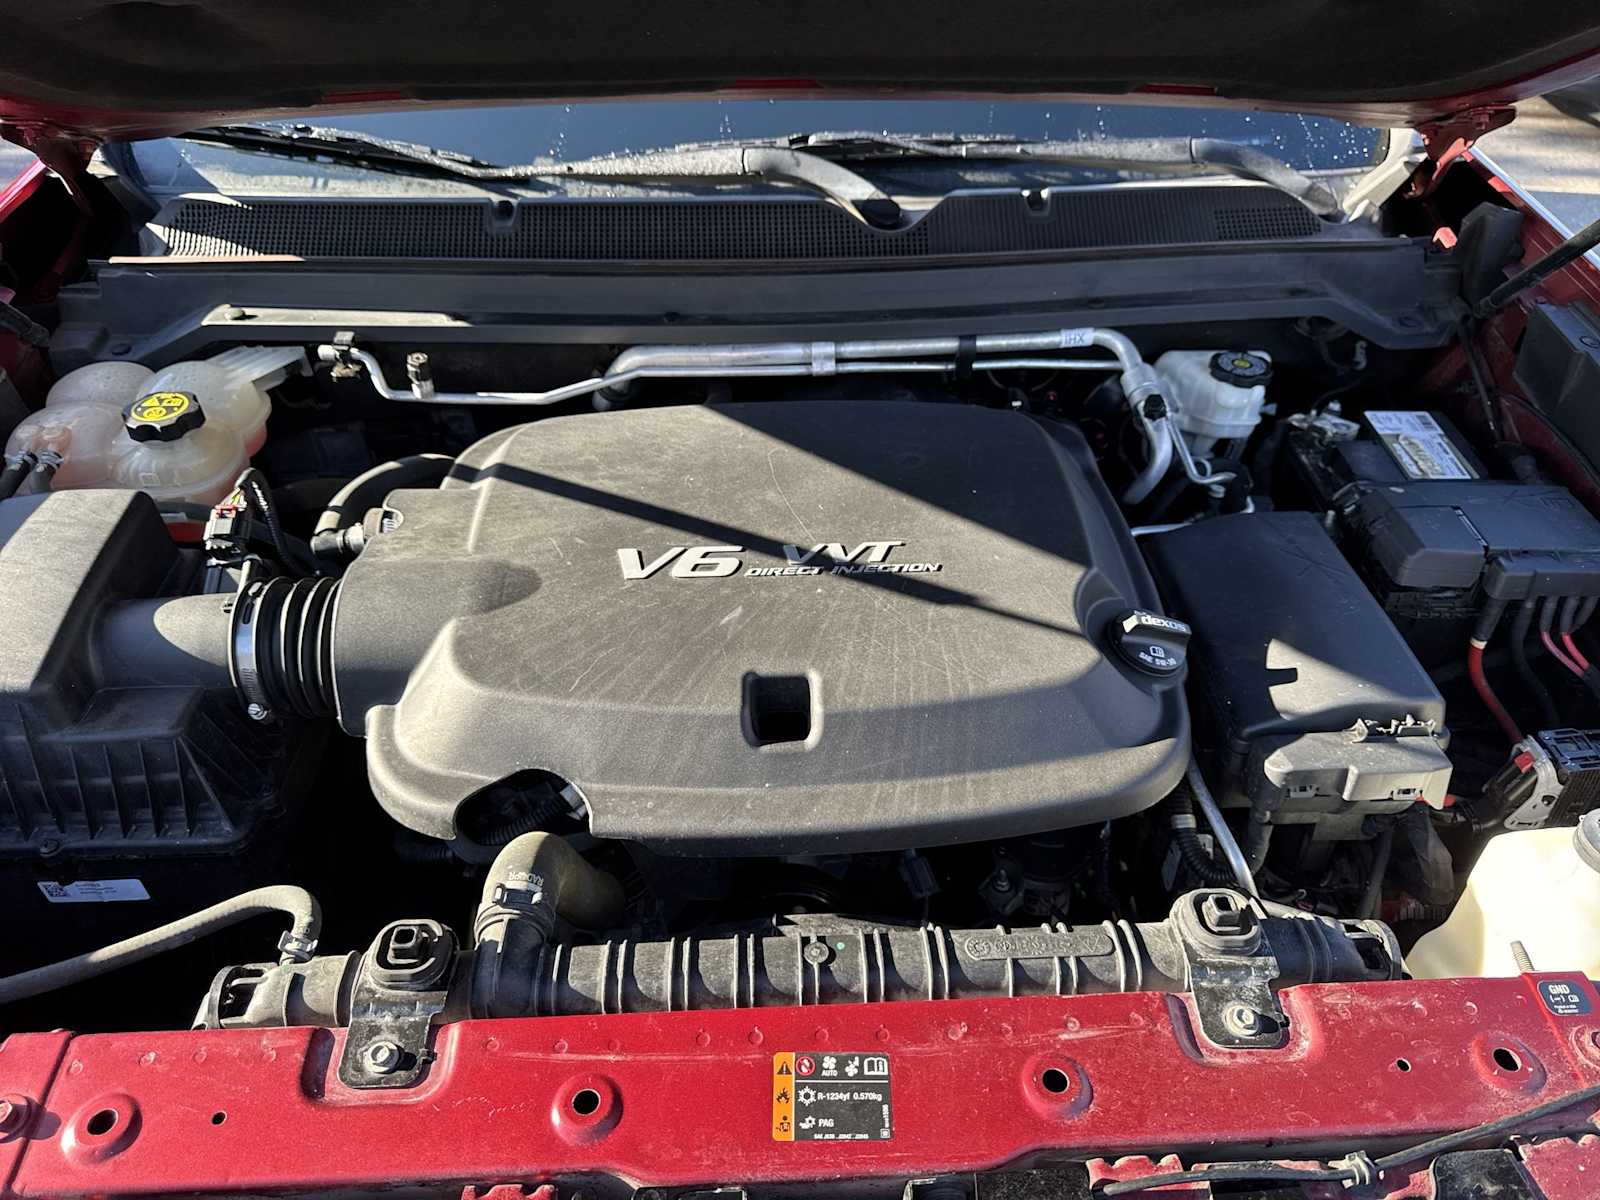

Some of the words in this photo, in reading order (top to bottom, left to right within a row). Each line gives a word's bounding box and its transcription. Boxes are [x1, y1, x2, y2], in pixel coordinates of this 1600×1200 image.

[617, 545, 744, 580] V6
[783, 541, 904, 565] VVT
[744, 565, 823, 577] DIRECT
[832, 562, 942, 576] INJECTION
[1141, 614, 1187, 632] dexos
[1548, 984, 1570, 995] GND
[821, 1069, 838, 1077] AUTO
[817, 1091, 850, 1102] R-1234yf
[853, 1091, 883, 1102] 0.570kg
[818, 1118, 835, 1128] PAG
